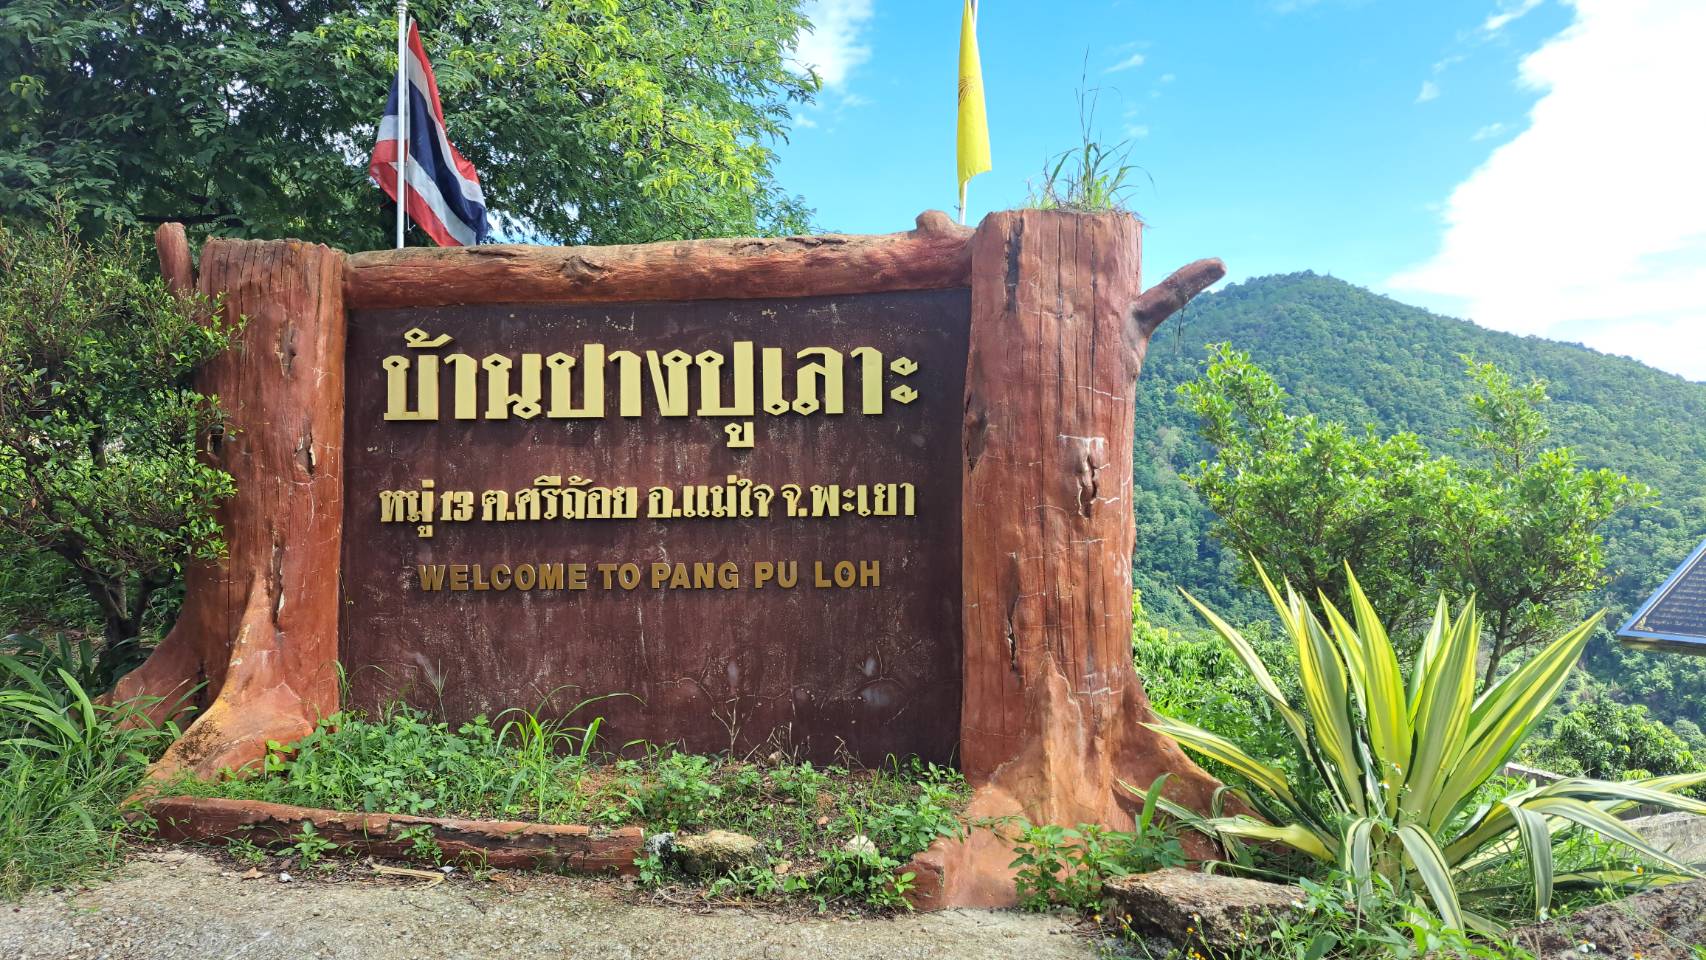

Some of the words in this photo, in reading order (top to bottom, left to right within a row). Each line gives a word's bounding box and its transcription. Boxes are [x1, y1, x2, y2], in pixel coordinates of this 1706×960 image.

[382, 327, 918, 447] บ้านปางปูเลาะ
[379, 479, 434, 537] หมู่
[440, 490, 474, 521] 13
[481, 475, 638, 521] ต.ศรีถ้อย
[647, 475, 775, 518] อ.แม่ใจ
[781, 482, 915, 517] จ.พะเยา
[418, 563, 588, 591] WELCOME
[598, 562, 641, 590] TO
[651, 561, 739, 590] PANG
[754, 560, 798, 589] PU
[814, 560, 880, 588] LOH
